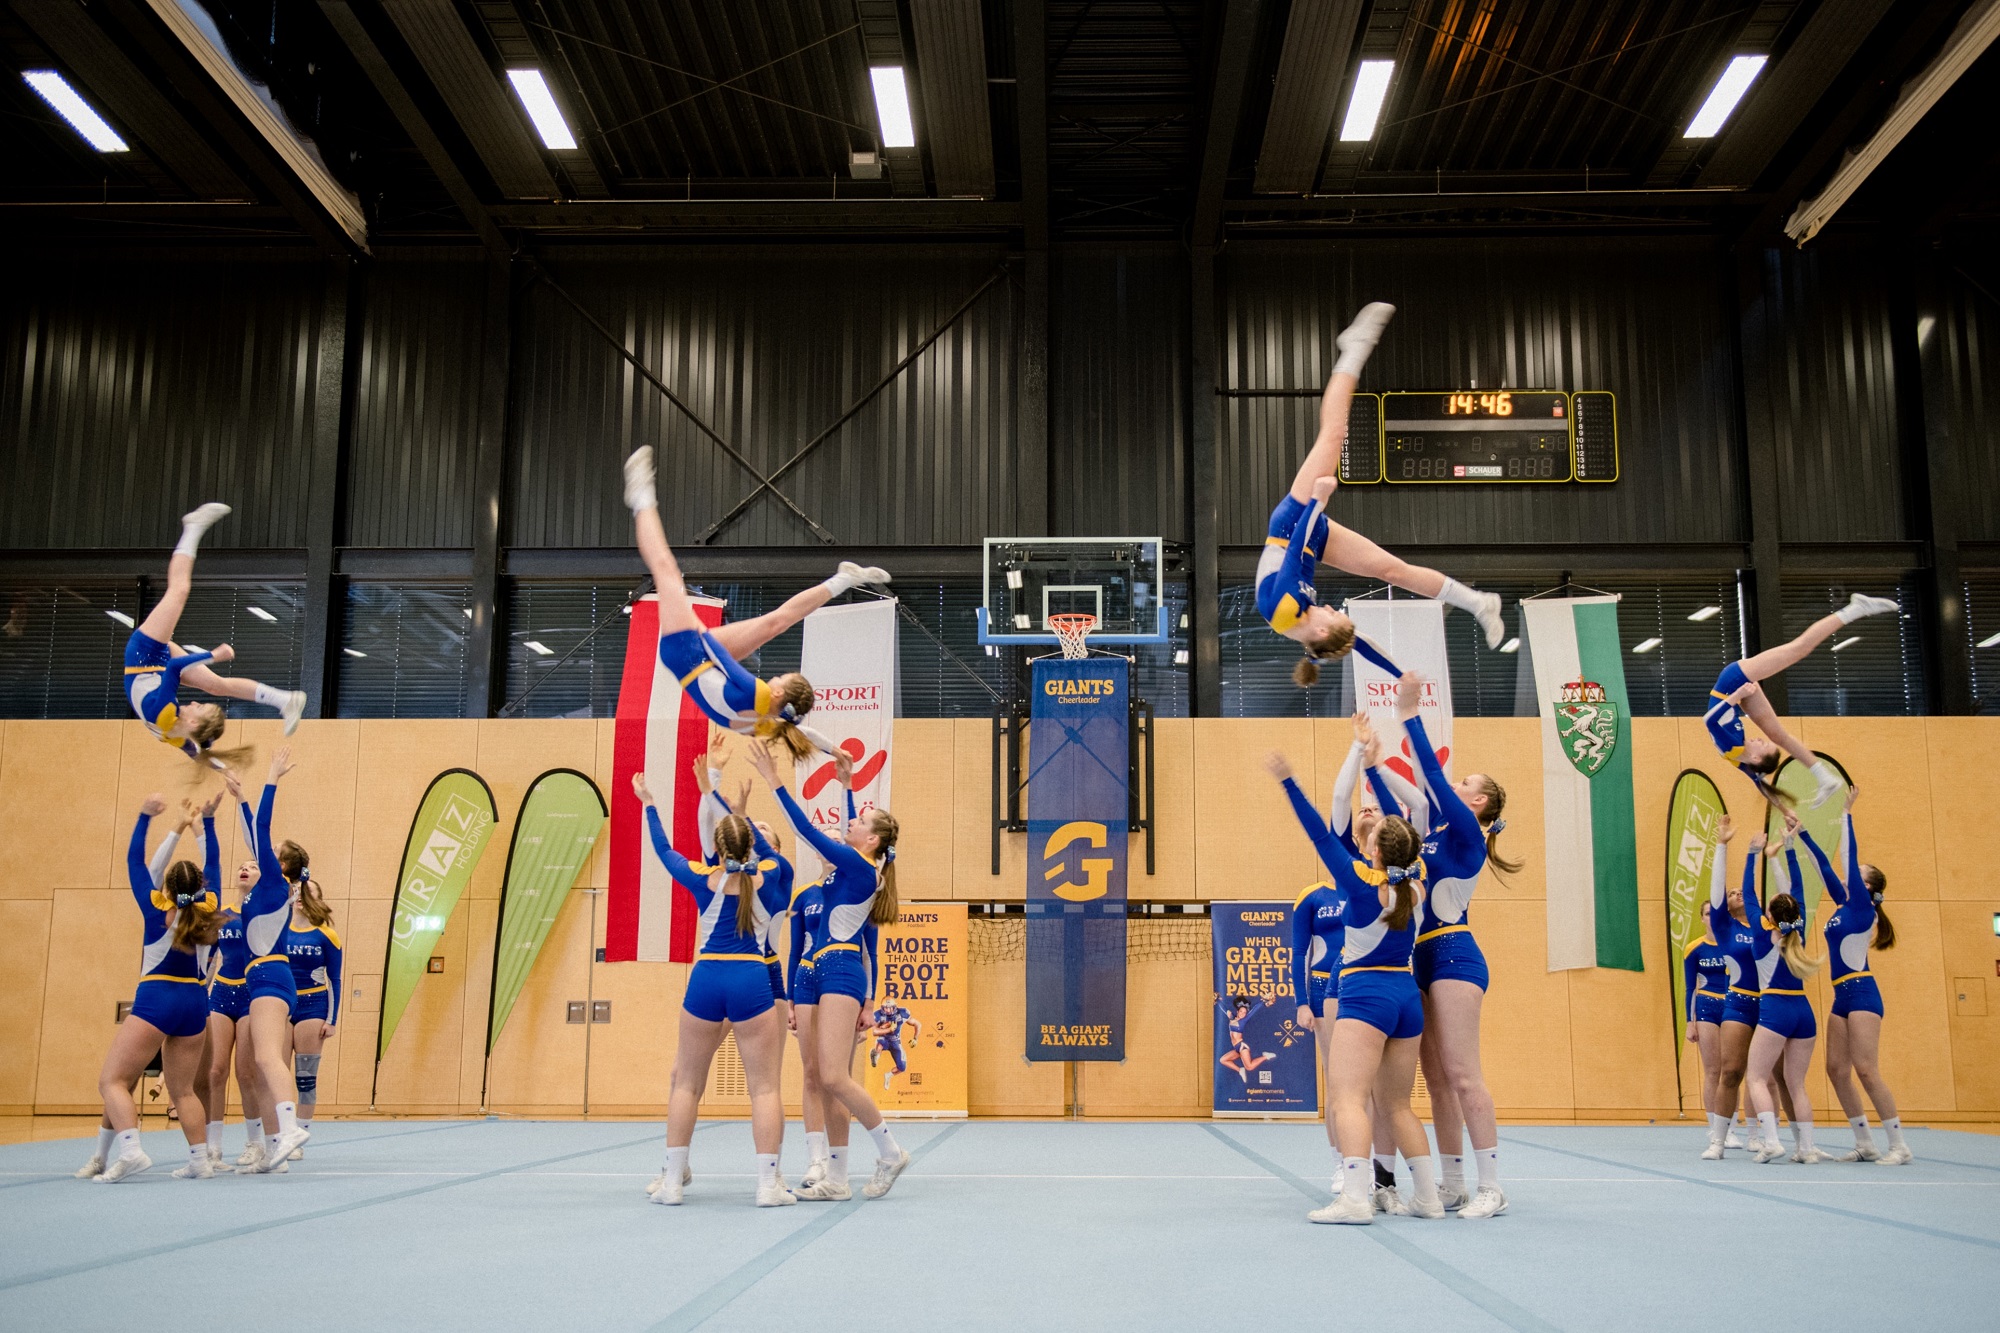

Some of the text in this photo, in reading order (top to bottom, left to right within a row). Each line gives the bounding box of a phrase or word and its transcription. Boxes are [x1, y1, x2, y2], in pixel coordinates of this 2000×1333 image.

[1449, 394, 1513, 416] 14:46
[813, 685, 881, 701] SPORT
[1044, 679, 1115, 696] GIANTS
[1367, 682, 1436, 697] SPOT
[812, 702, 879, 712] in Österreich
[1057, 696, 1101, 704] Cheerleader
[1369, 698, 1379, 707] in
[455, 810, 491, 870] HOLDING
[1043, 821, 1114, 902] G
[392, 802, 474, 940] GRAZ
[1670, 803, 1711, 941] GRAZ
[898, 914, 938, 922] GIANTS
[1240, 912, 1284, 922] GIANTS
[884, 938, 948, 954] MORE
[1244, 936, 1280, 946] WHEN
[888, 954, 946, 962] THAN JUST
[884, 964, 950, 981] FOOT
[884, 982, 948, 1000] BALL
[1040, 1024, 1113, 1034] BE A GIANT.
[1040, 1034, 1112, 1046] ALWAYS.
